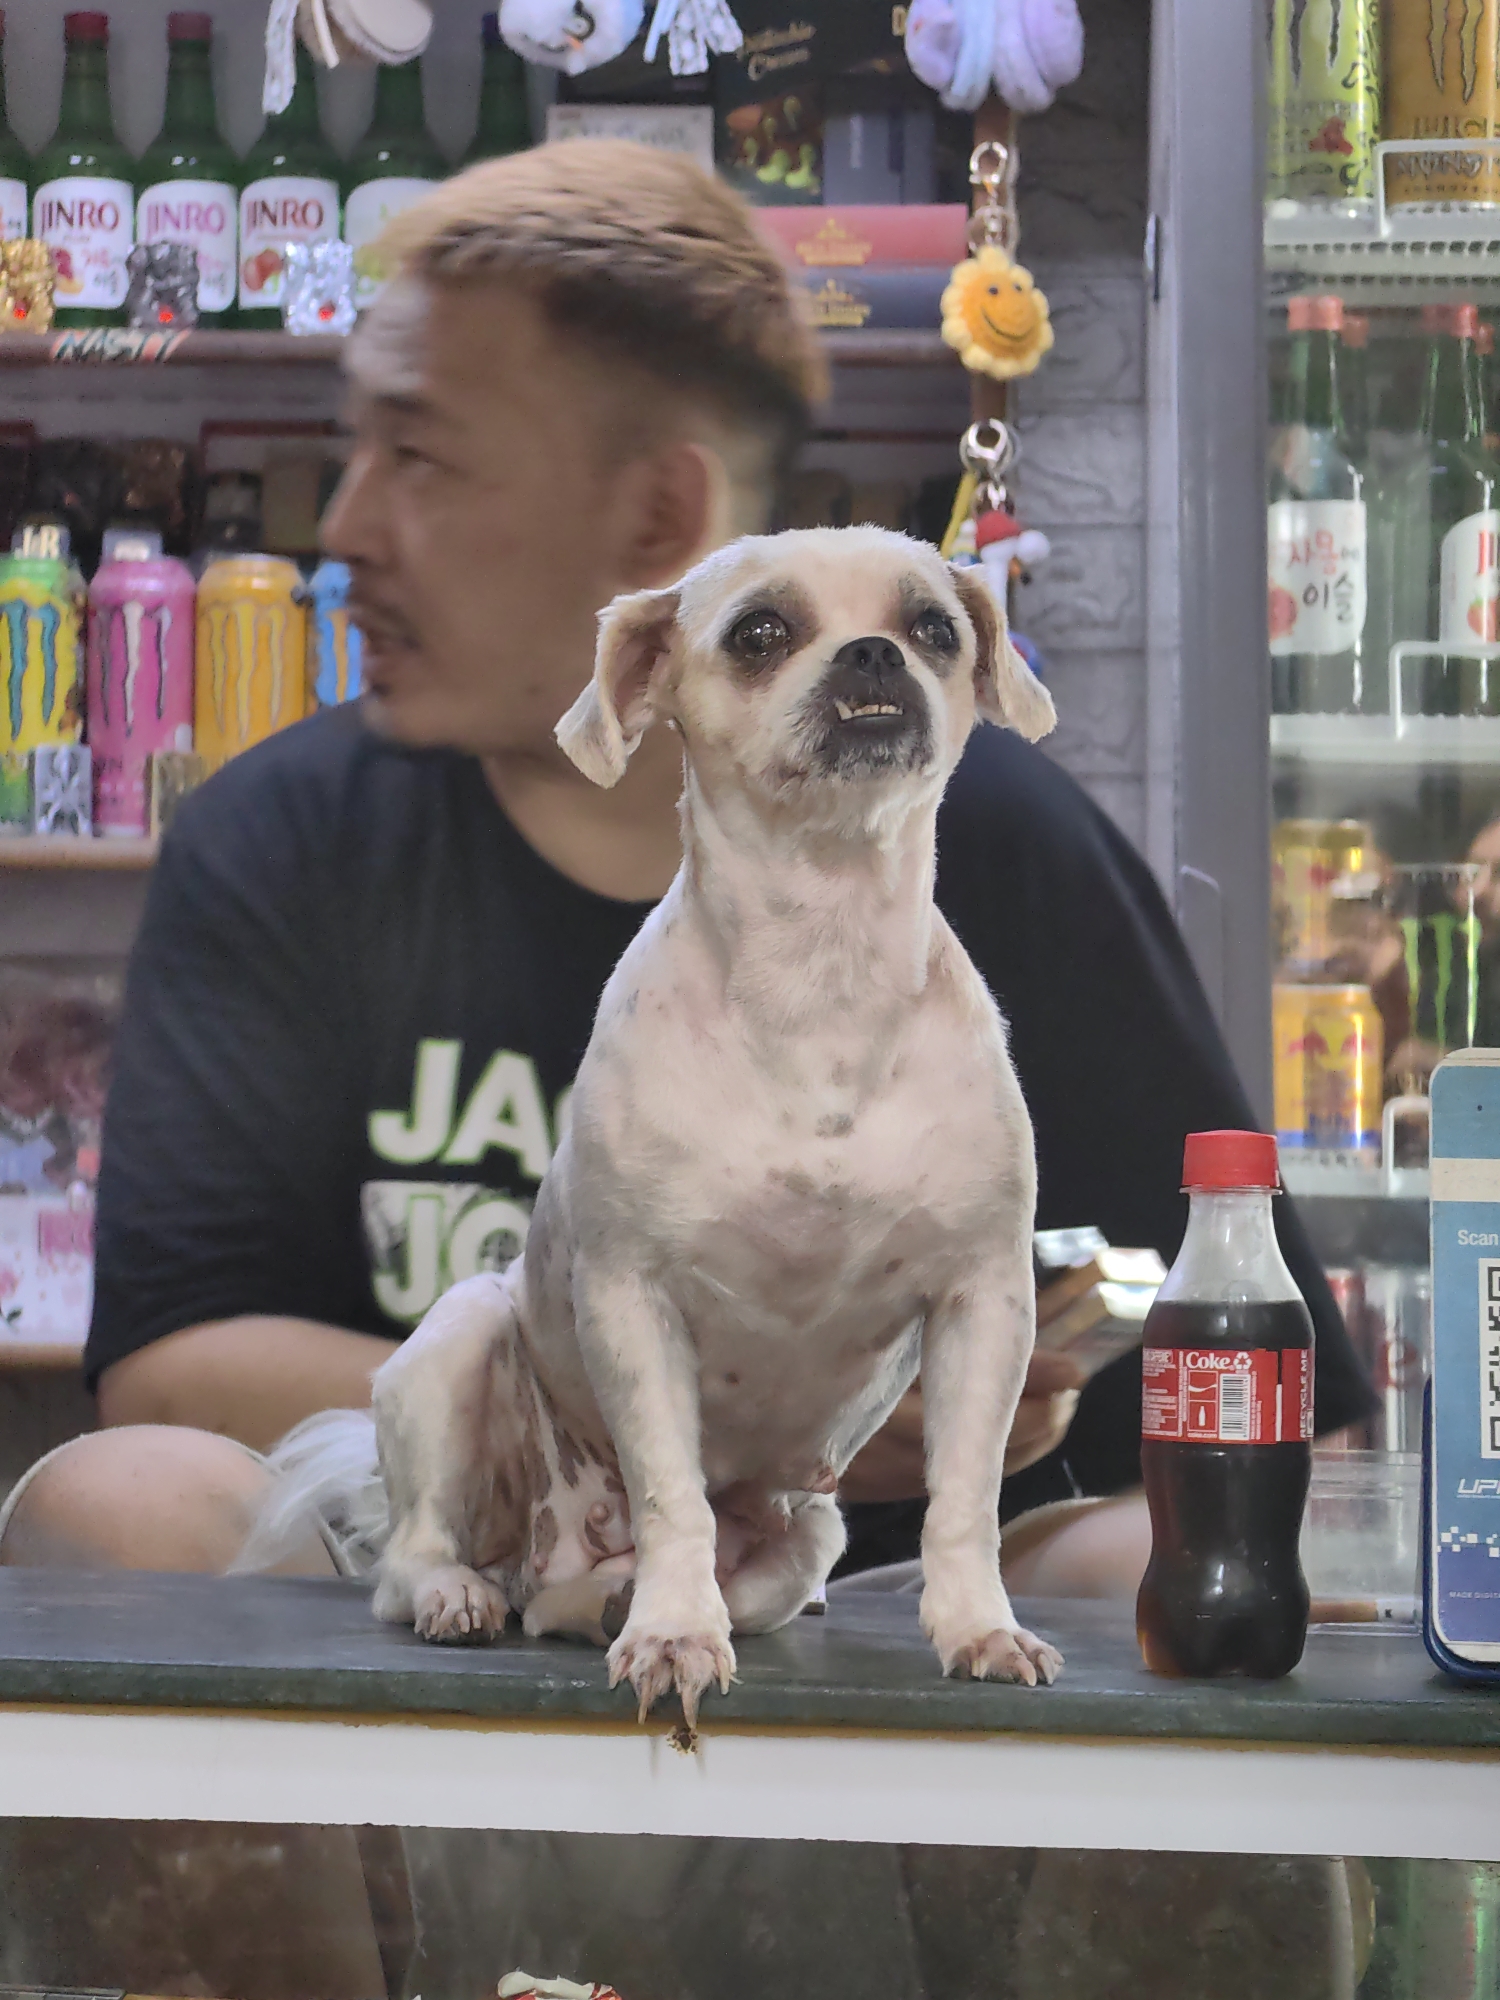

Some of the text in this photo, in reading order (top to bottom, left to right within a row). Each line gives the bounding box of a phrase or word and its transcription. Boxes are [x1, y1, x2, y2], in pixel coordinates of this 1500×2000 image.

[41, 200, 120, 237] JINRO
[146, 202, 225, 241] JINRO
[247, 199, 324, 237] JINRO
[367, 1037, 575, 1182] JA
[1457, 1230, 1499, 1246] Scan
[1186, 1352, 1231, 1369] Coke
